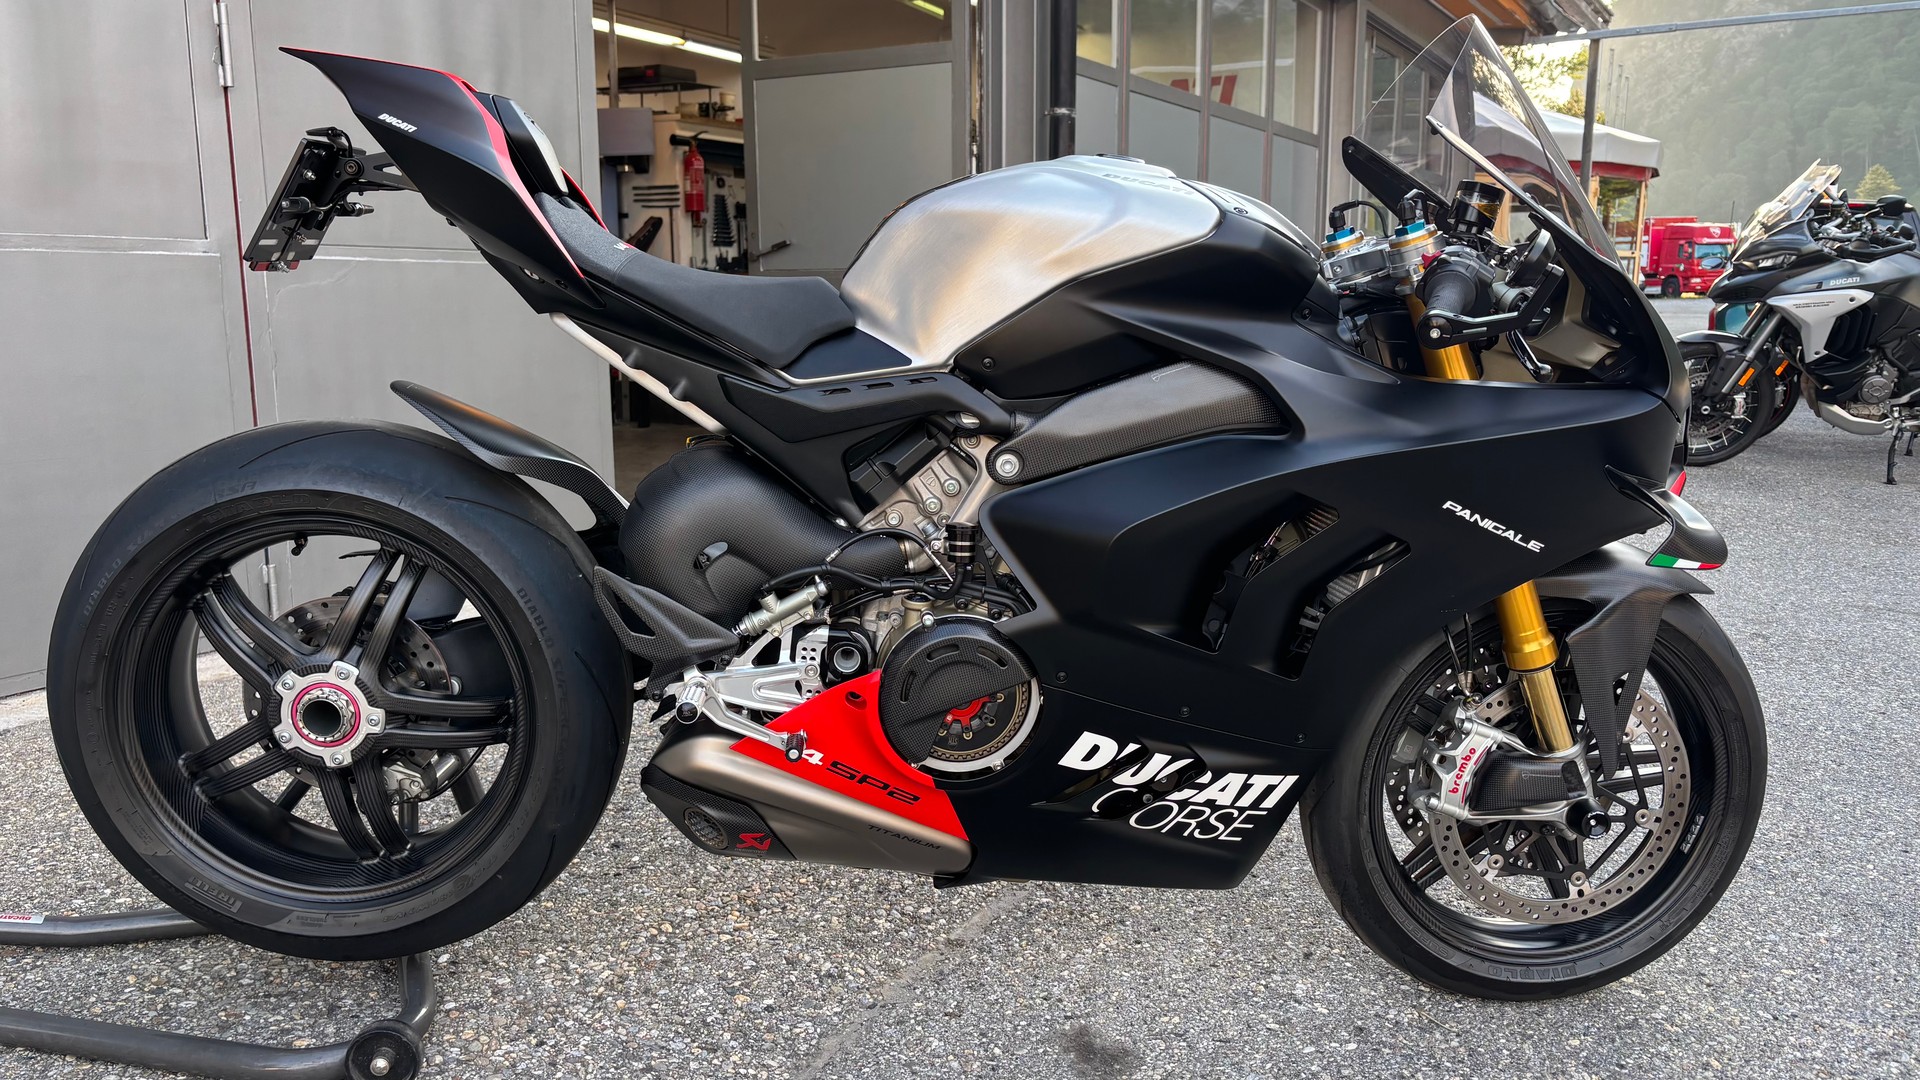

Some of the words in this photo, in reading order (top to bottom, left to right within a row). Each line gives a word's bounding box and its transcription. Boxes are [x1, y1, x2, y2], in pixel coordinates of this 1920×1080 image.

[377, 113, 418, 133] DUCATI
[1101, 173, 1195, 196] DUCATI
[1829, 276, 1860, 287] DUCATI
[1442, 500, 1545, 552] PANIGALE
[516, 587, 554, 649] DIABLO
[826, 760, 921, 806] SP2
[1057, 731, 1300, 809] DUCATI
[1448, 747, 1477, 795] brembo
[1091, 787, 1268, 842] CORSE
[868, 824, 943, 850] TITANIUM
[184, 876, 243, 913] PIRELLI
[1487, 963, 1579, 981] DIABLO
